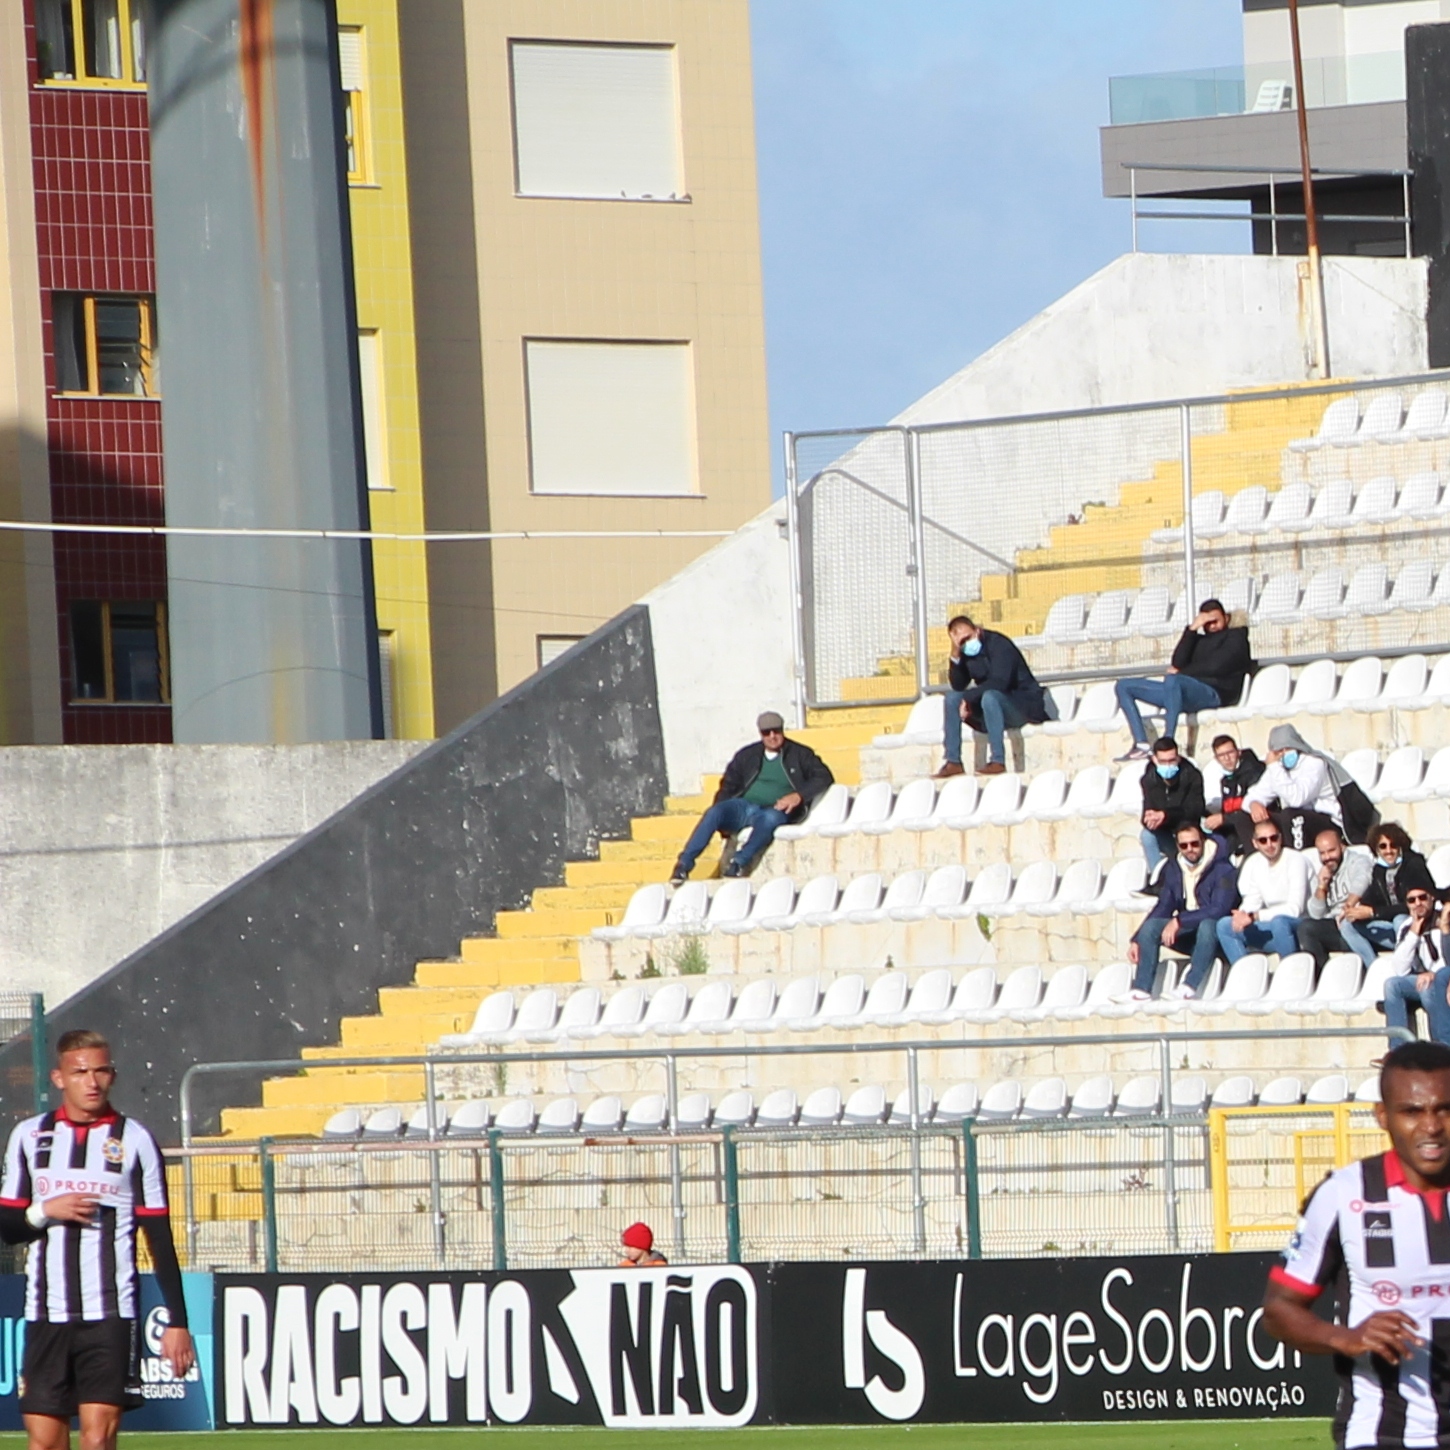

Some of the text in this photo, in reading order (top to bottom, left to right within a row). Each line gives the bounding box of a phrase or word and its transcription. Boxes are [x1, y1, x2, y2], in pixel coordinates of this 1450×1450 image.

[54, 1180, 119, 1195] PROTEU
[224, 1273, 752, 1425] RACISMO NÃO
[953, 1262, 1302, 1404] LageSobra
[1103, 1384, 1305, 1413] DESIGN & RENOVAÇÃO
